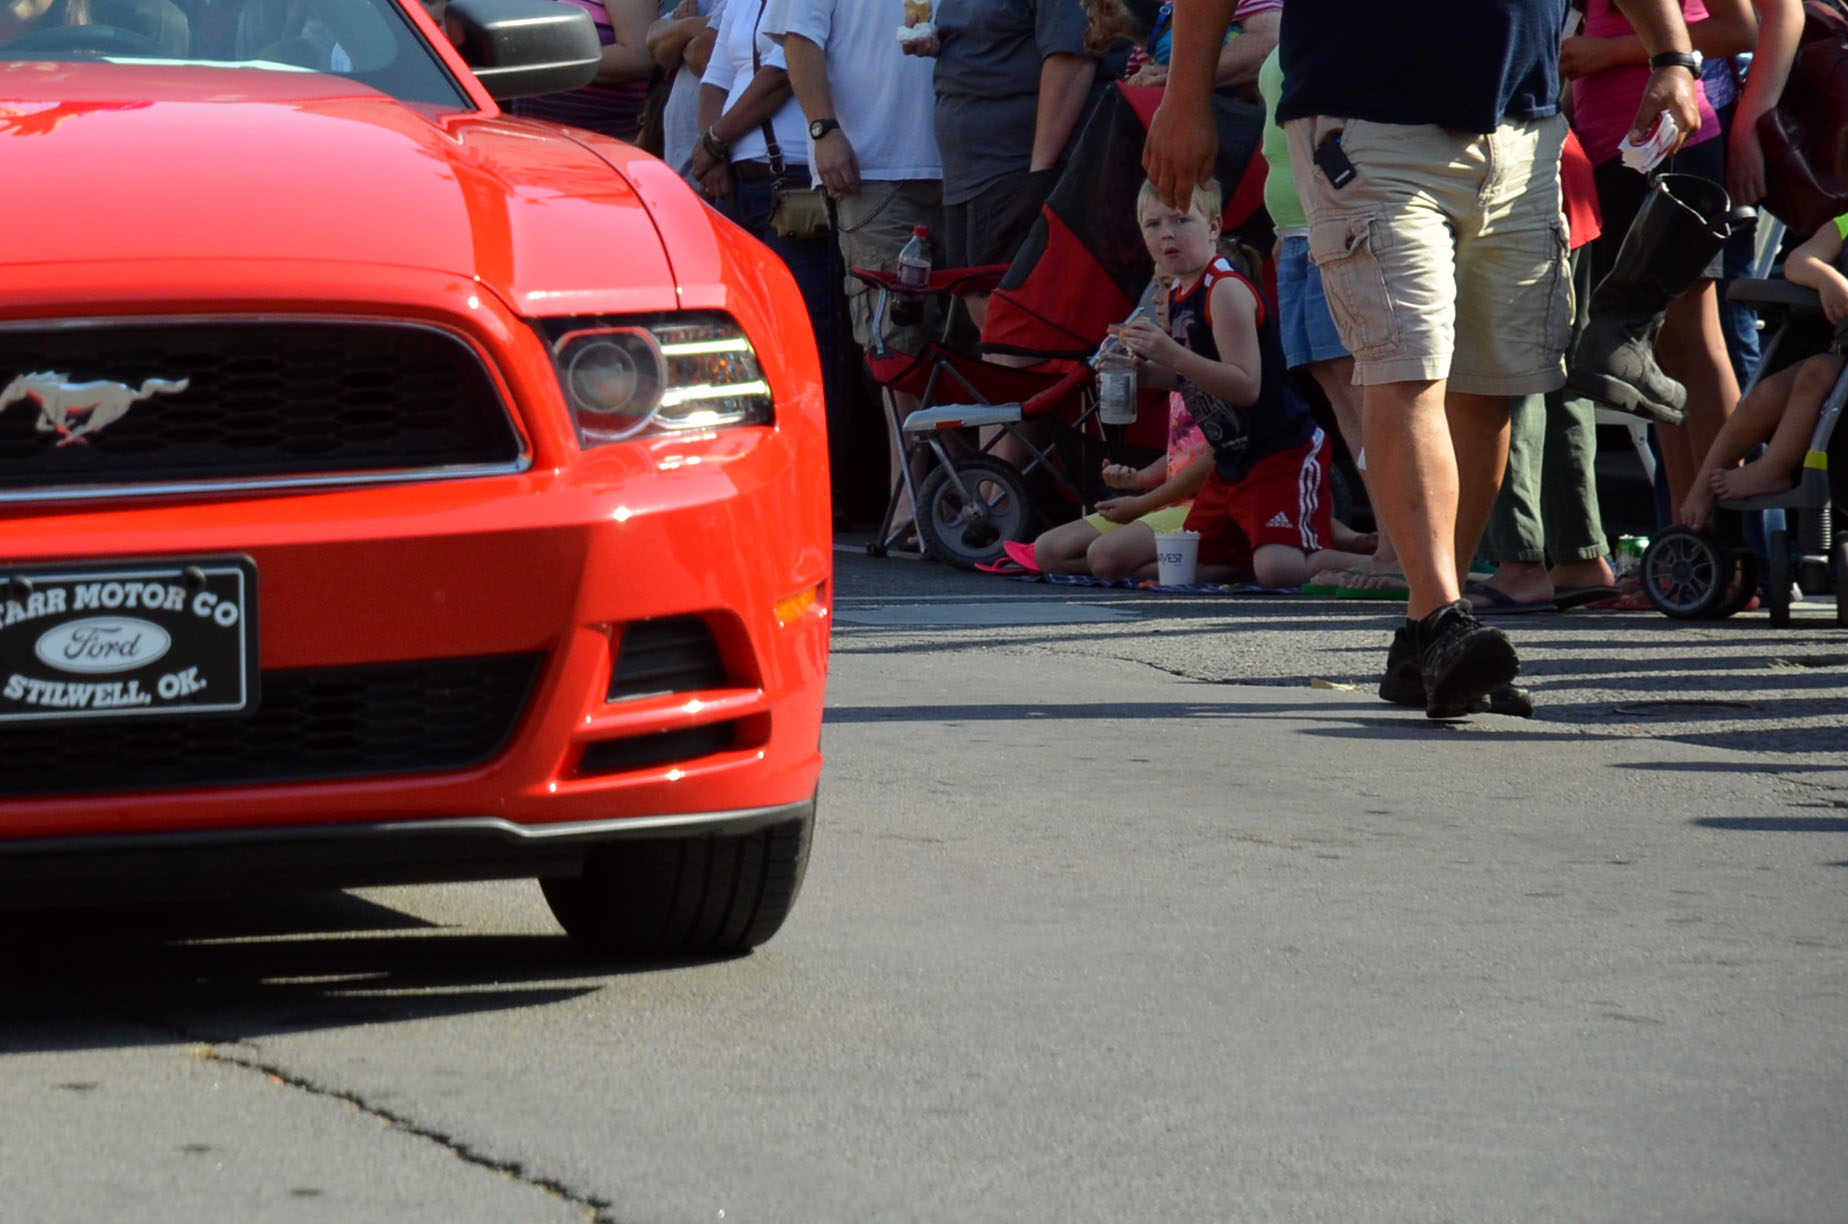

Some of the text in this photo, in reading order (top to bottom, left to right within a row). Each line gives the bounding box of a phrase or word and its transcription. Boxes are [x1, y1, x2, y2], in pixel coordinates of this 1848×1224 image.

[73, 582, 186, 612] MOTOR
[192, 592, 239, 626] CO
[63, 626, 142, 660] Ford
[157, 666, 207, 699] OK.
